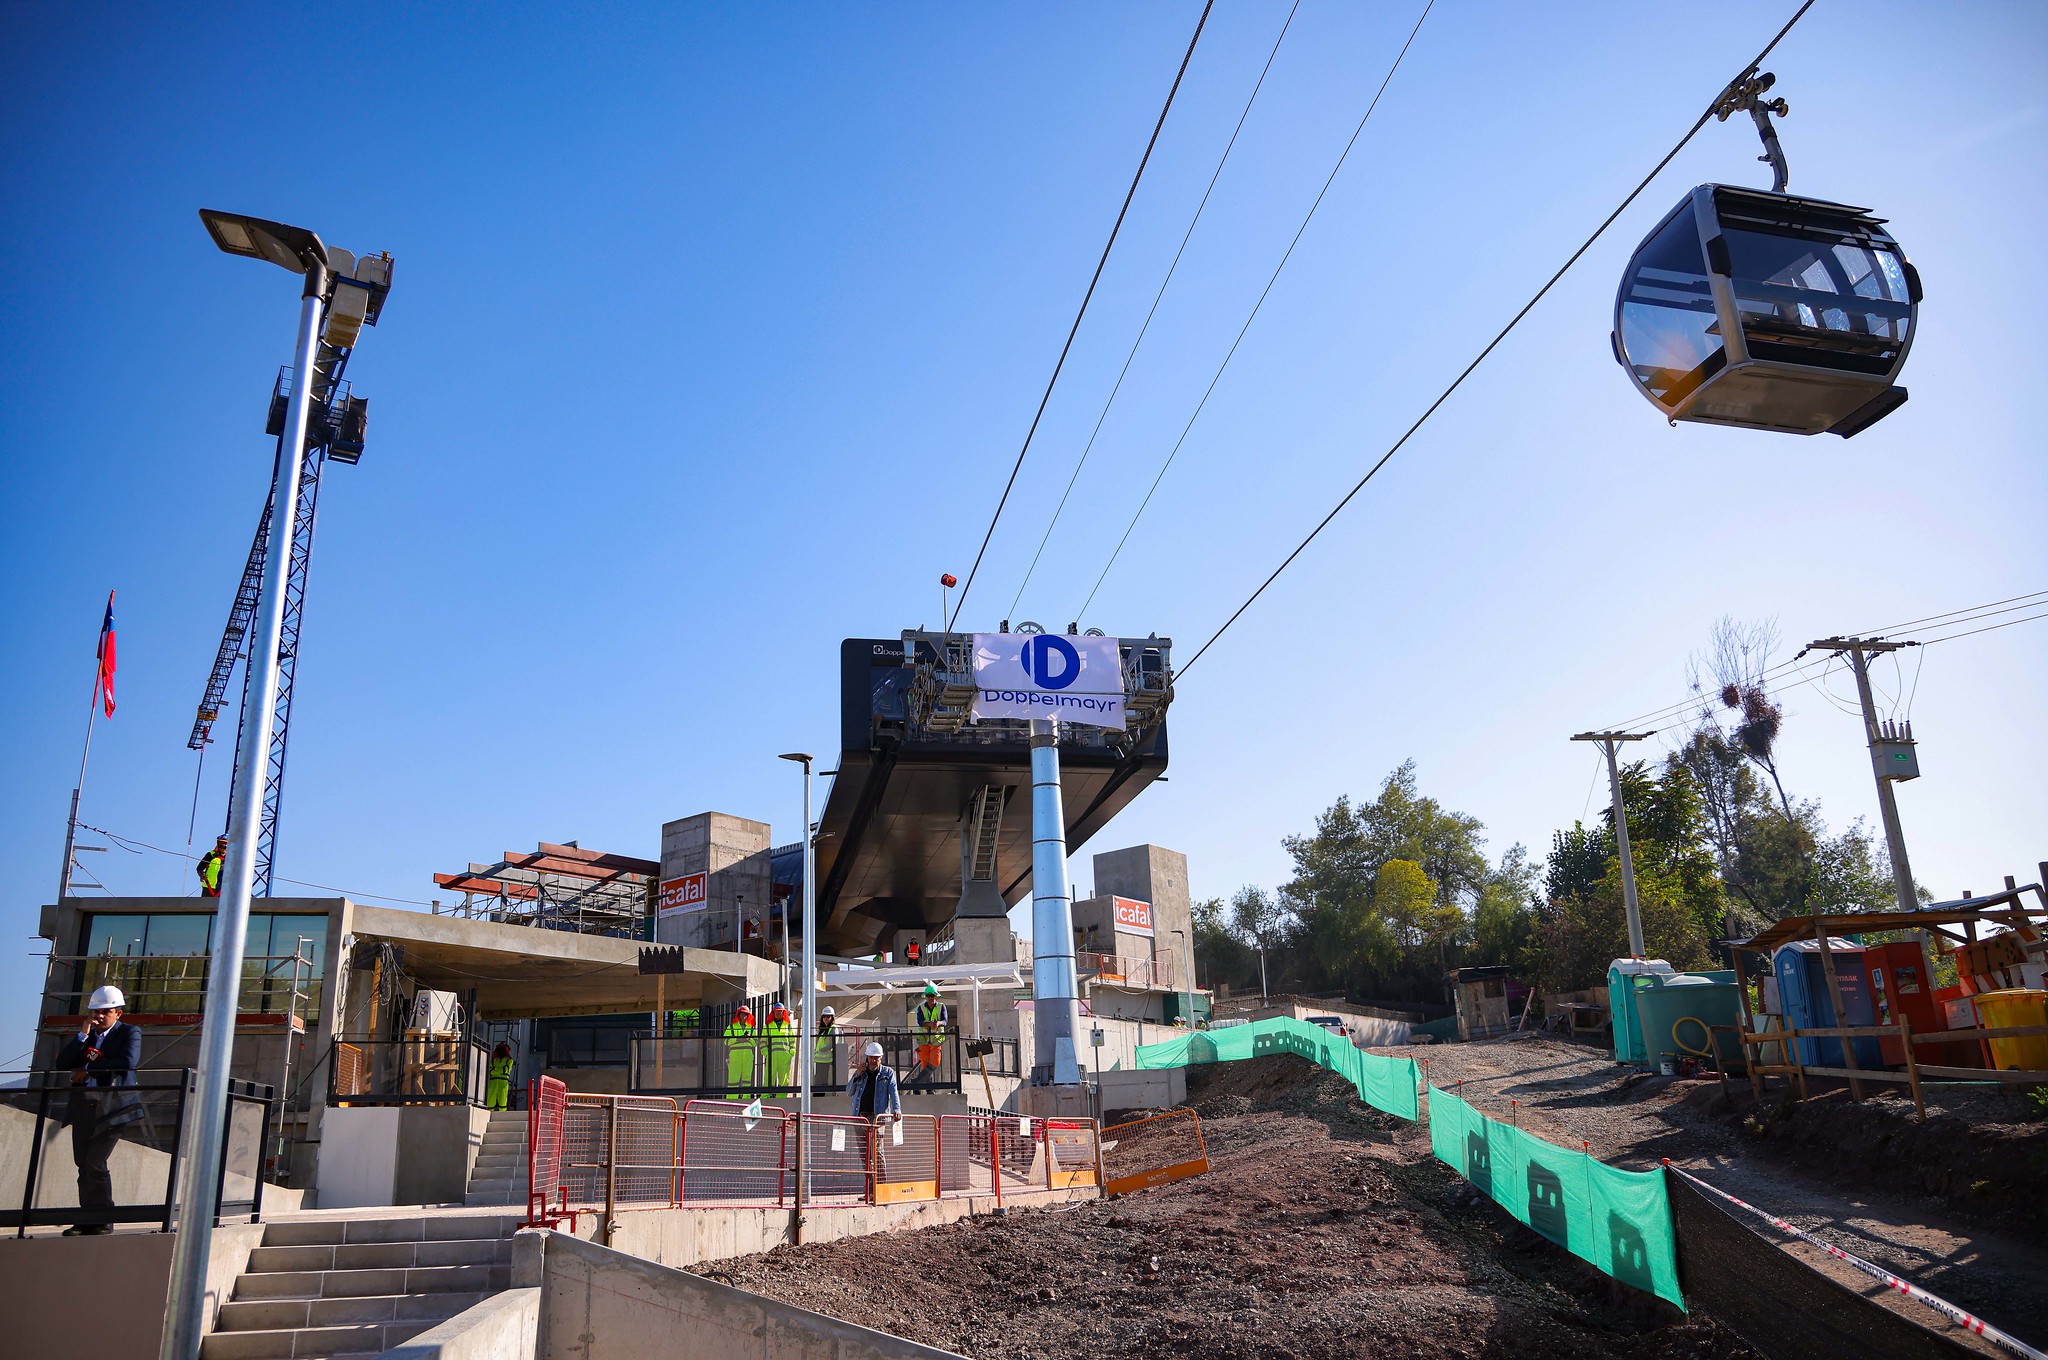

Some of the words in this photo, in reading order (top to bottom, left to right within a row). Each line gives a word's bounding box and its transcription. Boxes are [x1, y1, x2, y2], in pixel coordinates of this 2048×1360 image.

[984, 690, 1117, 713] Doppelmayr
[662, 877, 704, 907] icafal
[1115, 900, 1151, 926] icafal
